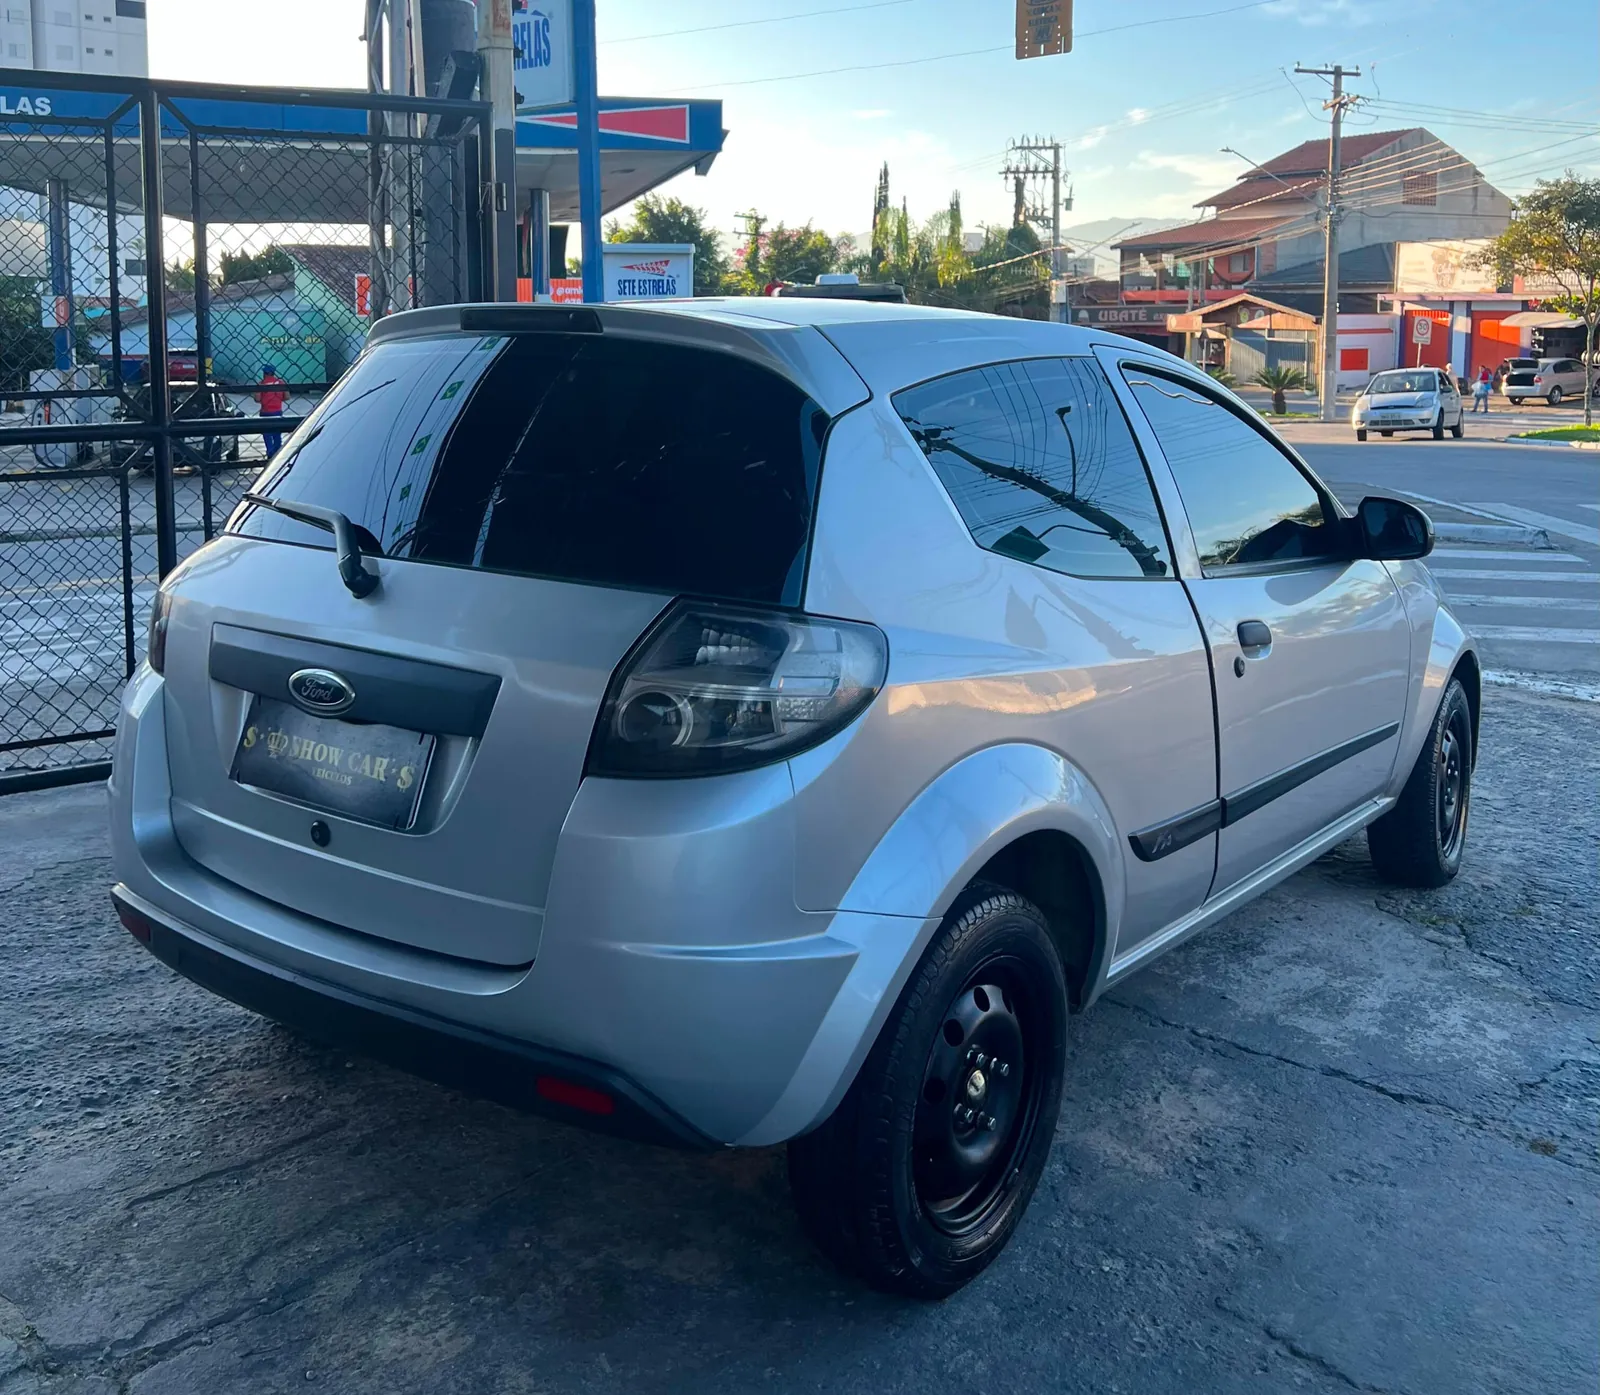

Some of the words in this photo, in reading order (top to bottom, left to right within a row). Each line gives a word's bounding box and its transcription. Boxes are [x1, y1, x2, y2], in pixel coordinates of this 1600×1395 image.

[0, 95, 52, 117] LAS
[617, 279, 637, 296] SETE
[638, 279, 677, 296] ESTRELAS
[1098, 308, 1148, 322] UBATÉ
[300, 677, 333, 702] Ford
[288, 735, 345, 767] SHOW
